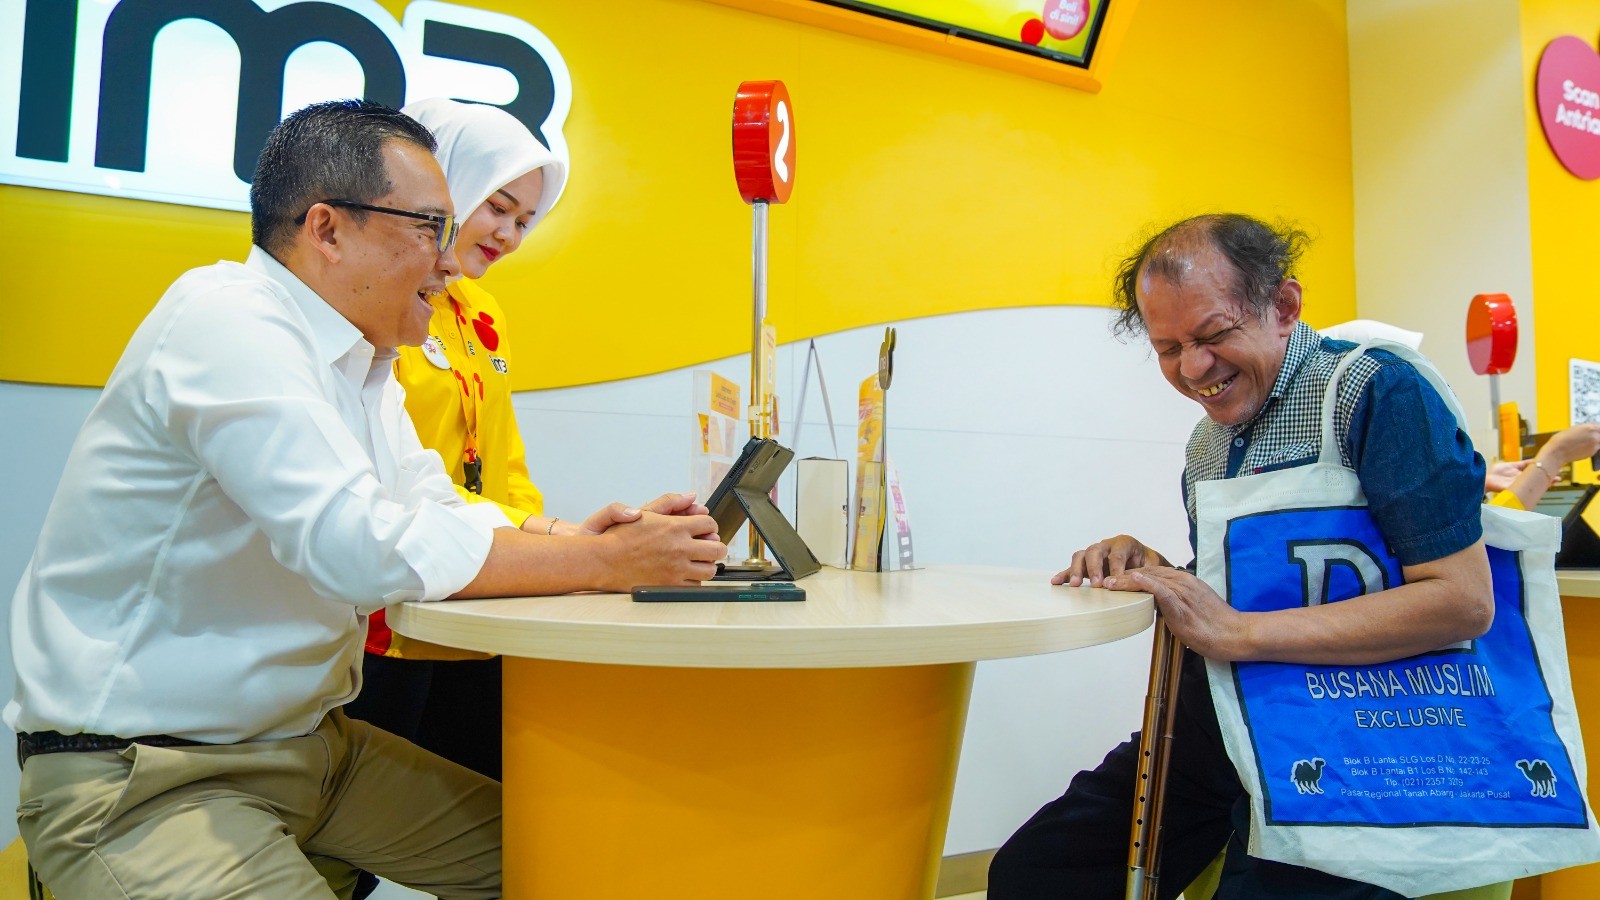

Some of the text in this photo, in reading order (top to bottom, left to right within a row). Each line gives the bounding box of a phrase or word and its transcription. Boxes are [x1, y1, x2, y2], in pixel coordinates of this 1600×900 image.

[1562, 79, 1600, 109] Scan
[774, 100, 789, 183] 2
[1305, 663, 1496, 700] BUSANA MUSLIM
[1354, 707, 1467, 729] EXCLUSIVE
[1343, 757, 1361, 765] Blok
[1363, 756, 1371, 764] B
[1372, 756, 1397, 764] Lantai
[1399, 755, 1419, 764] SLG
[1437, 755, 1443, 763] D
[1458, 756, 1491, 765] 22-23-25
[1350, 767, 1369, 776] Blok
[1371, 767, 1378, 776] B
[1407, 766, 1419, 775] B1
[1421, 766, 1436, 775] Los
[1437, 766, 1445, 774] B
[1458, 767, 1489, 776] 142-143
[1401, 778, 1424, 787] (021)
[1425, 778, 1446, 786] 2357
[1363, 790, 1401, 800] Regional
[1403, 789, 1429, 797] Tanah
[1429, 789, 1454, 799] Abang
[1487, 790, 1511, 798] Pusat
